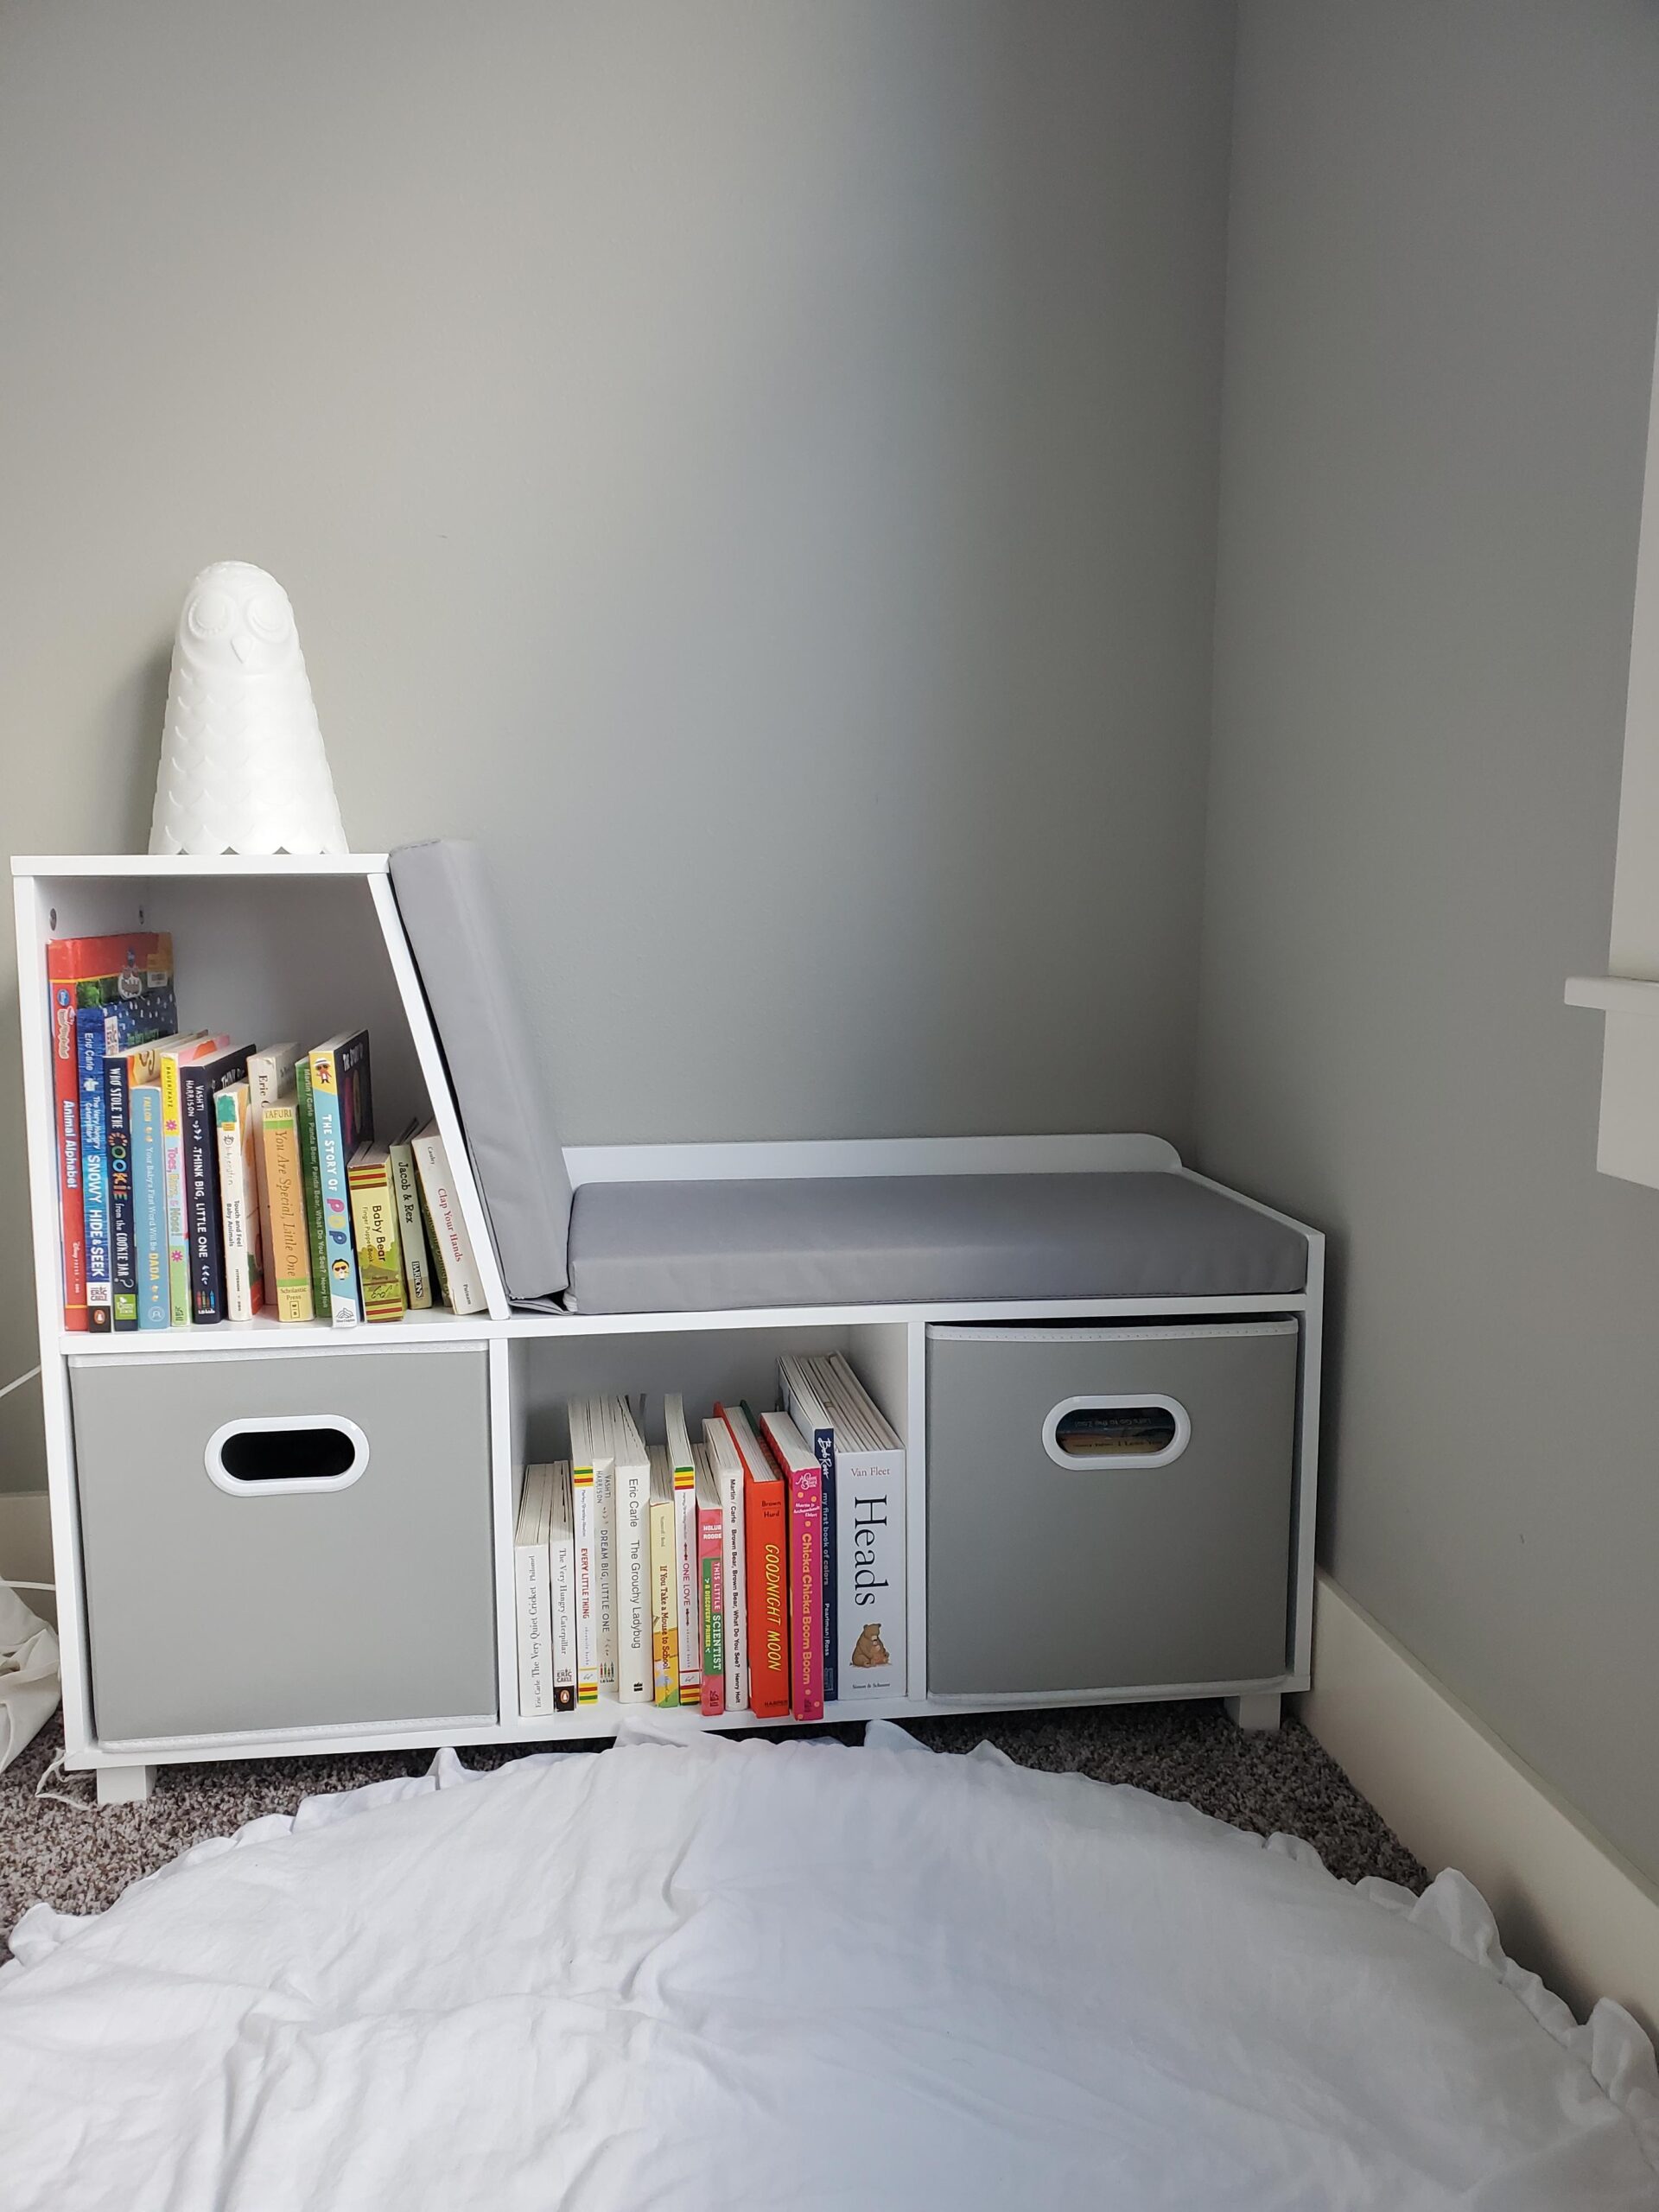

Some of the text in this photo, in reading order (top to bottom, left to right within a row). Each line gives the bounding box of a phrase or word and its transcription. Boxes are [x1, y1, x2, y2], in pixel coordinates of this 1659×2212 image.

[85, 1033, 95, 1071] Eric Carle
[110, 1067, 122, 1087] WHO
[258, 1075, 269, 1096] Eric
[111, 1089, 123, 1115] STOLE
[186, 1080, 195, 1117] HARRISON
[195, 1085, 205, 1112] VASHTI
[92, 1108, 101, 1124] Very
[111, 1116, 124, 1128] THE
[265, 1109, 292, 1120] TAFURI
[64, 1101, 79, 1188] Animal Alphabet
[87, 1155, 103, 1204] SNOWY
[108, 1132, 131, 1201] COOKIE
[322, 1114, 347, 1245] THE STORY OF POP
[193, 1149, 209, 1258] THINK BIG, LITTLE ONE
[276, 1131, 299, 1277] You Are Special, Little One
[398, 1162, 410, 1191] Jacob
[404, 1204, 415, 1224] Rex
[88, 1210, 104, 1238] HIDE
[114, 1203, 125, 1219] from
[372, 1205, 384, 1234] Baby
[116, 1220, 126, 1231] the
[317, 1230, 324, 1239] Do
[437, 1188, 463, 1262] Clap Your Hands
[116, 1232, 129, 1262] COOKIE
[376, 1236, 386, 1262] Bear
[91, 1247, 105, 1277] SEEK
[149, 1253, 160, 1281] DADA
[817, 1437, 832, 1459] Bob
[850, 1466, 890, 1477] Van Fleet
[822, 1493, 828, 1507] my
[581, 1548, 589, 1571] EVERY
[823, 1549, 830, 1559] of
[855, 1494, 889, 1606] Heads
[629, 1478, 643, 1649] Eric Carle The Grouchy Ladybug
[582, 1573, 590, 1596] LITTLE
[600, 1529, 611, 1632] DREAM BIG, LITTLE ONE
[659, 1573, 668, 1586] You
[528, 1586, 537, 1616] Cricket
[557, 1548, 569, 1655] The Very Hungry Caterpillar
[582, 1597, 590, 1618] THING
[660, 1587, 669, 1605] Take
[765, 1544, 782, 1672] GOODNIGHT MOON
[802, 1533, 813, 1685] Chicka Chicka Boom Boom
[529, 1618, 541, 1640] Quiet
[661, 1612, 670, 1636] Mouse
[734, 1628, 741, 1637] Do
[531, 1643, 542, 1661] Very
[713, 1615, 722, 1670] SCIENTIST
[662, 1645, 671, 1669] School
[531, 1666, 540, 1678] The
